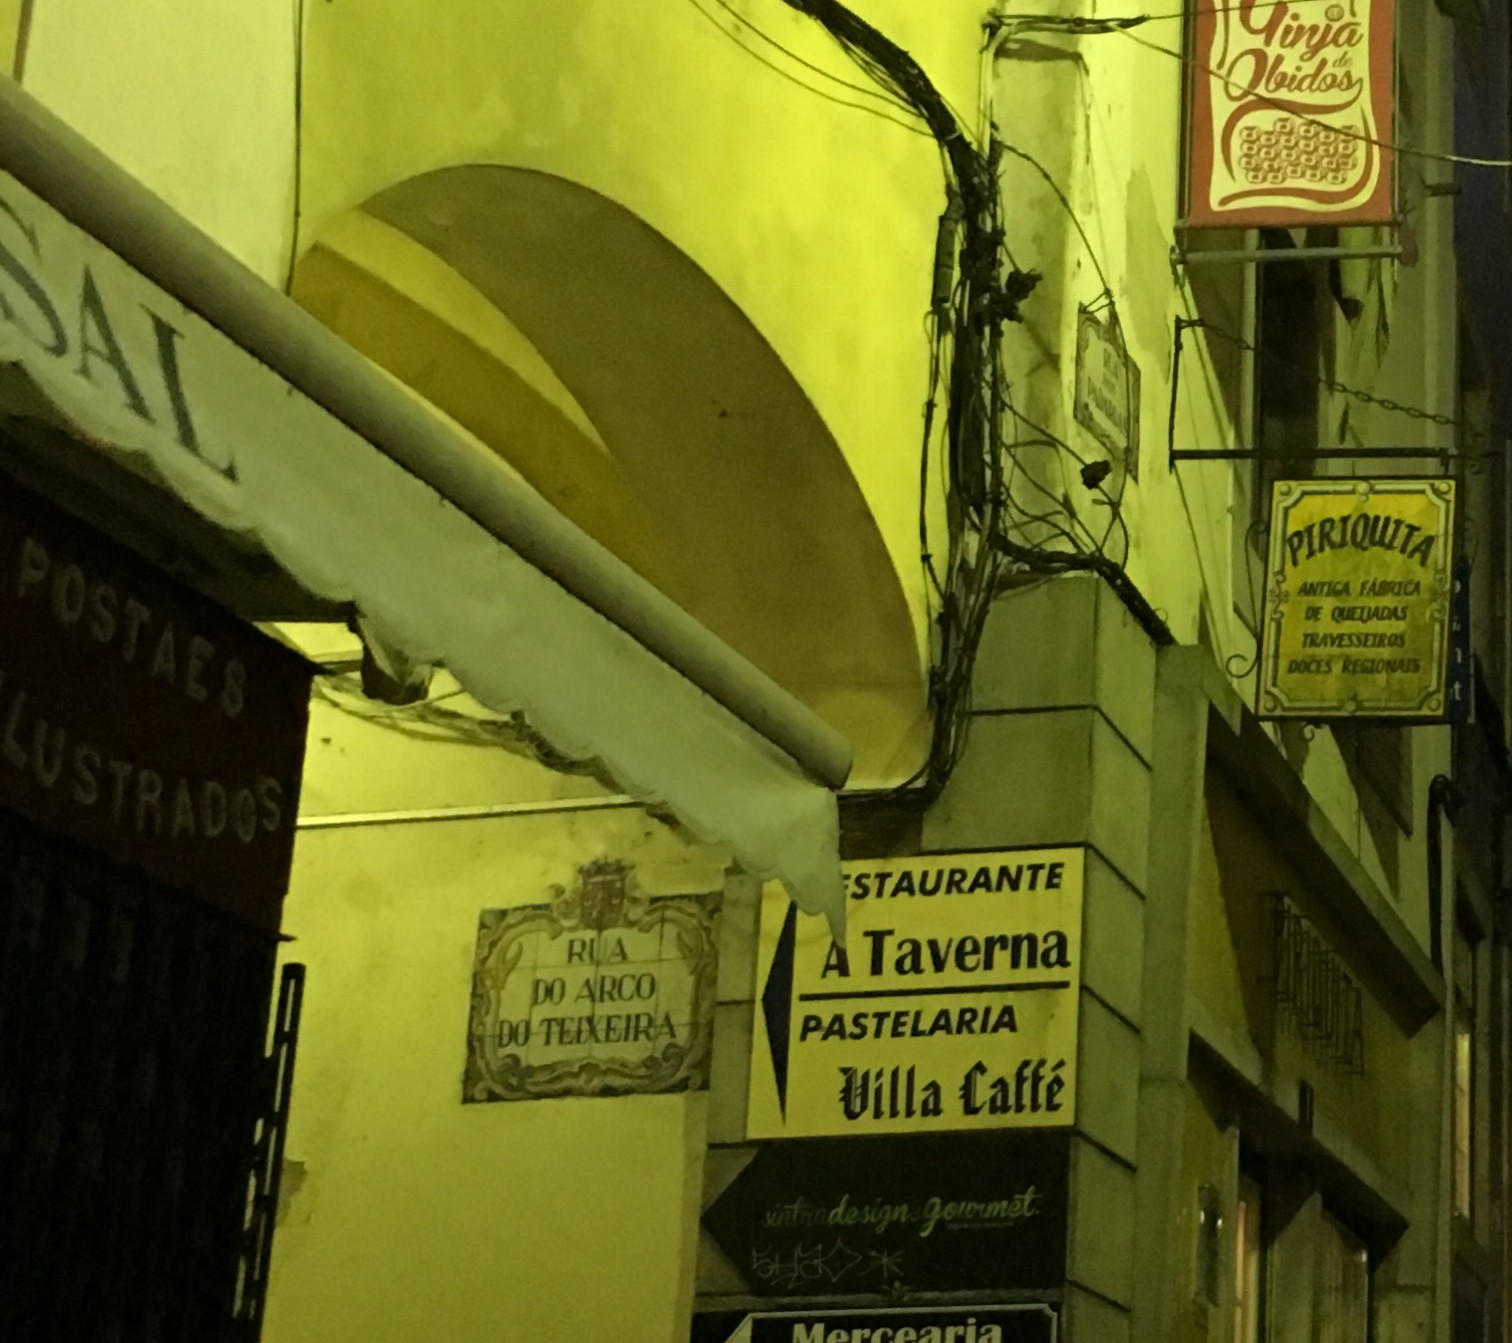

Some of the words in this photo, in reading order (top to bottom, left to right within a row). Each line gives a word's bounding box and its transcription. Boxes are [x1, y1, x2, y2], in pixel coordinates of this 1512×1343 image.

[1286, 513, 1436, 568] PIRIQUITA
[1297, 581, 1352, 597] ANTIGA
[1358, 578, 1421, 596] FÁBRICA
[18, 536, 248, 720] POSTAES
[1304, 606, 1323, 621] DE
[1331, 606, 1408, 623] QUEIJADAS
[1302, 633, 1406, 649] TRAVESSEIROS
[1287, 659, 1333, 674] DOCES
[1341, 658, 1421, 674] REGIONAIS
[0, 666, 285, 844] LUSTRADOS
[567, 936, 629, 963] RUA
[821, 939, 851, 979] A
[862, 928, 1072, 977] Taverna
[534, 977, 566, 1006] DO
[575, 972, 656, 1003] ARCO
[498, 1020, 530, 1048] DO
[541, 1012, 678, 1046] TEIXEIRA
[800, 1005, 1019, 1042] PASTELARIA
[838, 1064, 944, 1121] Villa
[958, 1058, 1067, 1117] Caffé
